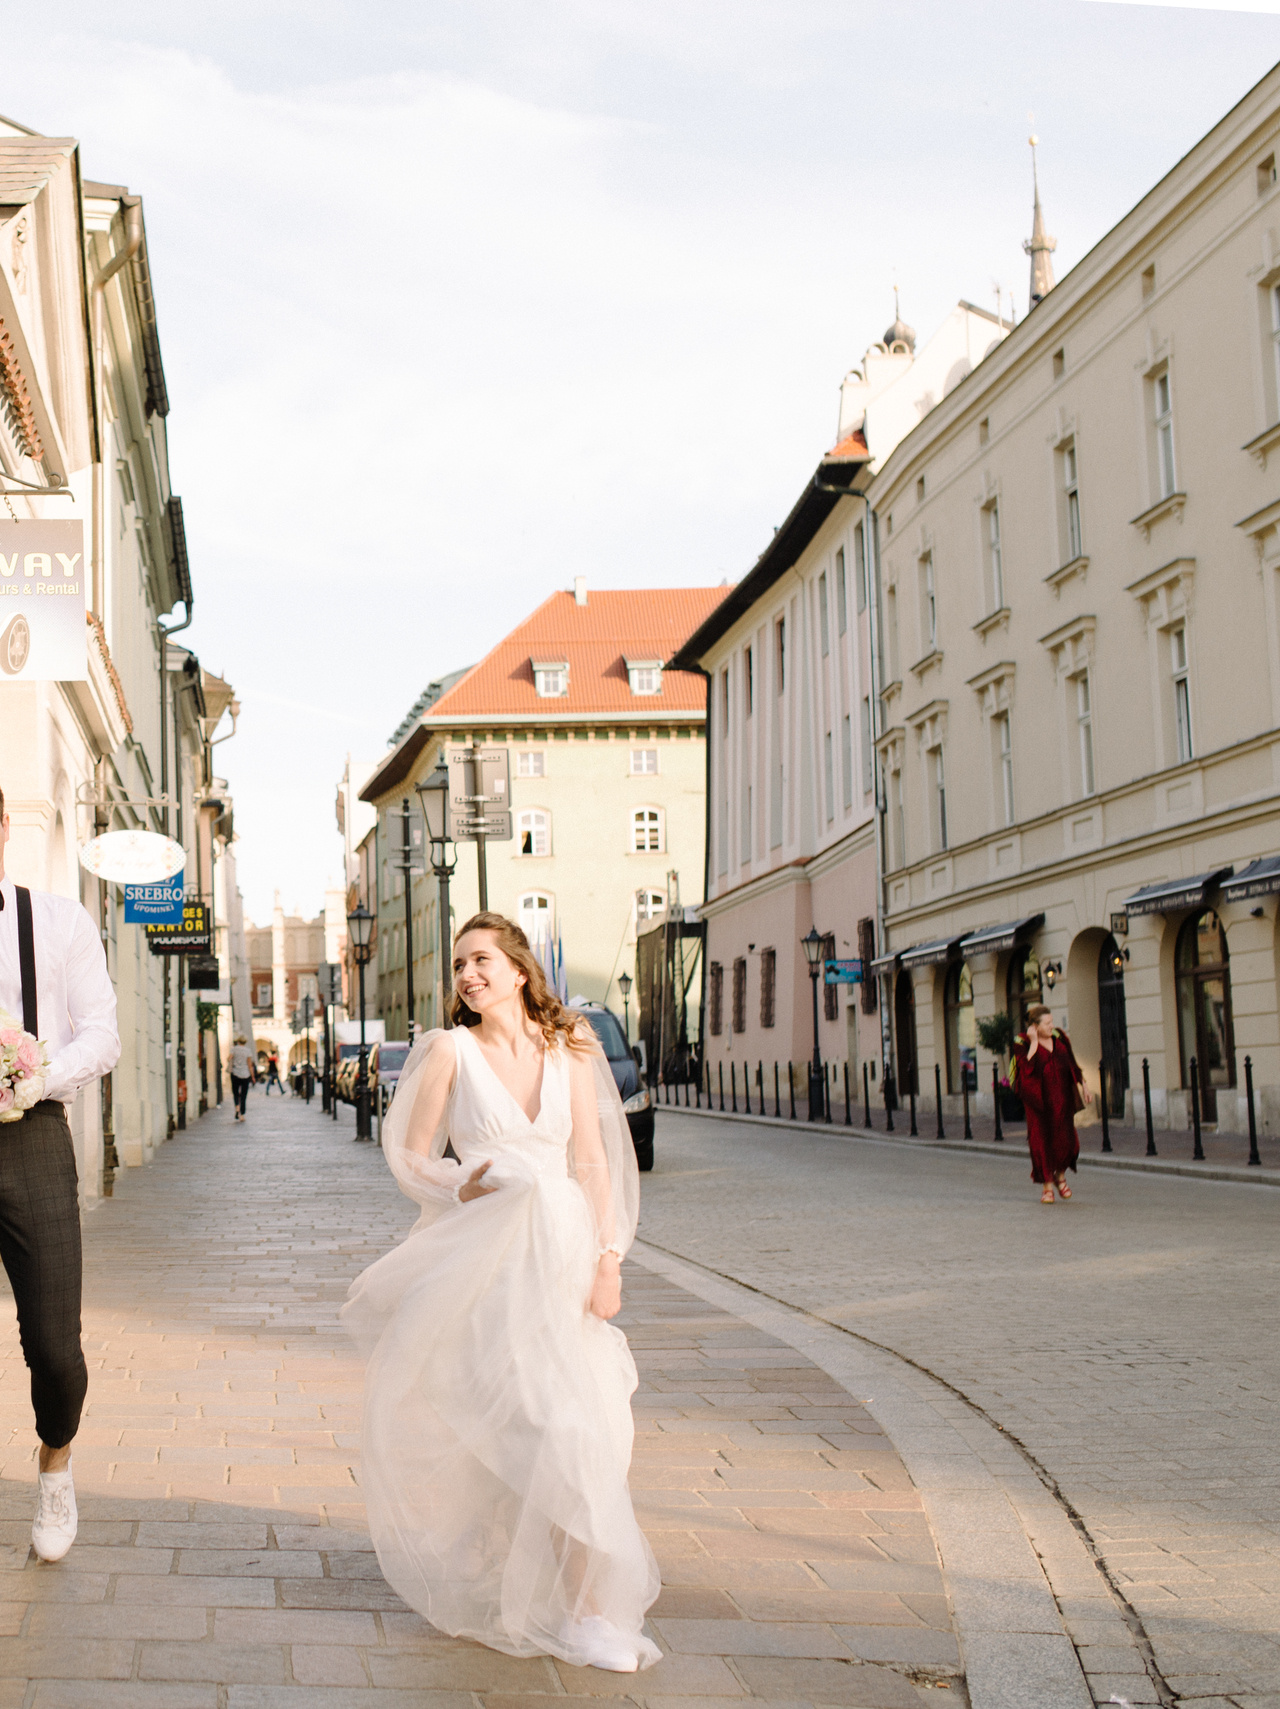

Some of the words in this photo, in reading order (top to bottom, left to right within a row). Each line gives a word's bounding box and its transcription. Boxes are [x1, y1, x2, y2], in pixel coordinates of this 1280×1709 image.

[22, 582, 33, 596] &
[36, 581, 80, 596] Rental
[125, 886, 184, 902] SREBRO
[133, 903, 175, 914] UPOMINKI
[147, 919, 204, 933] KANTOR
